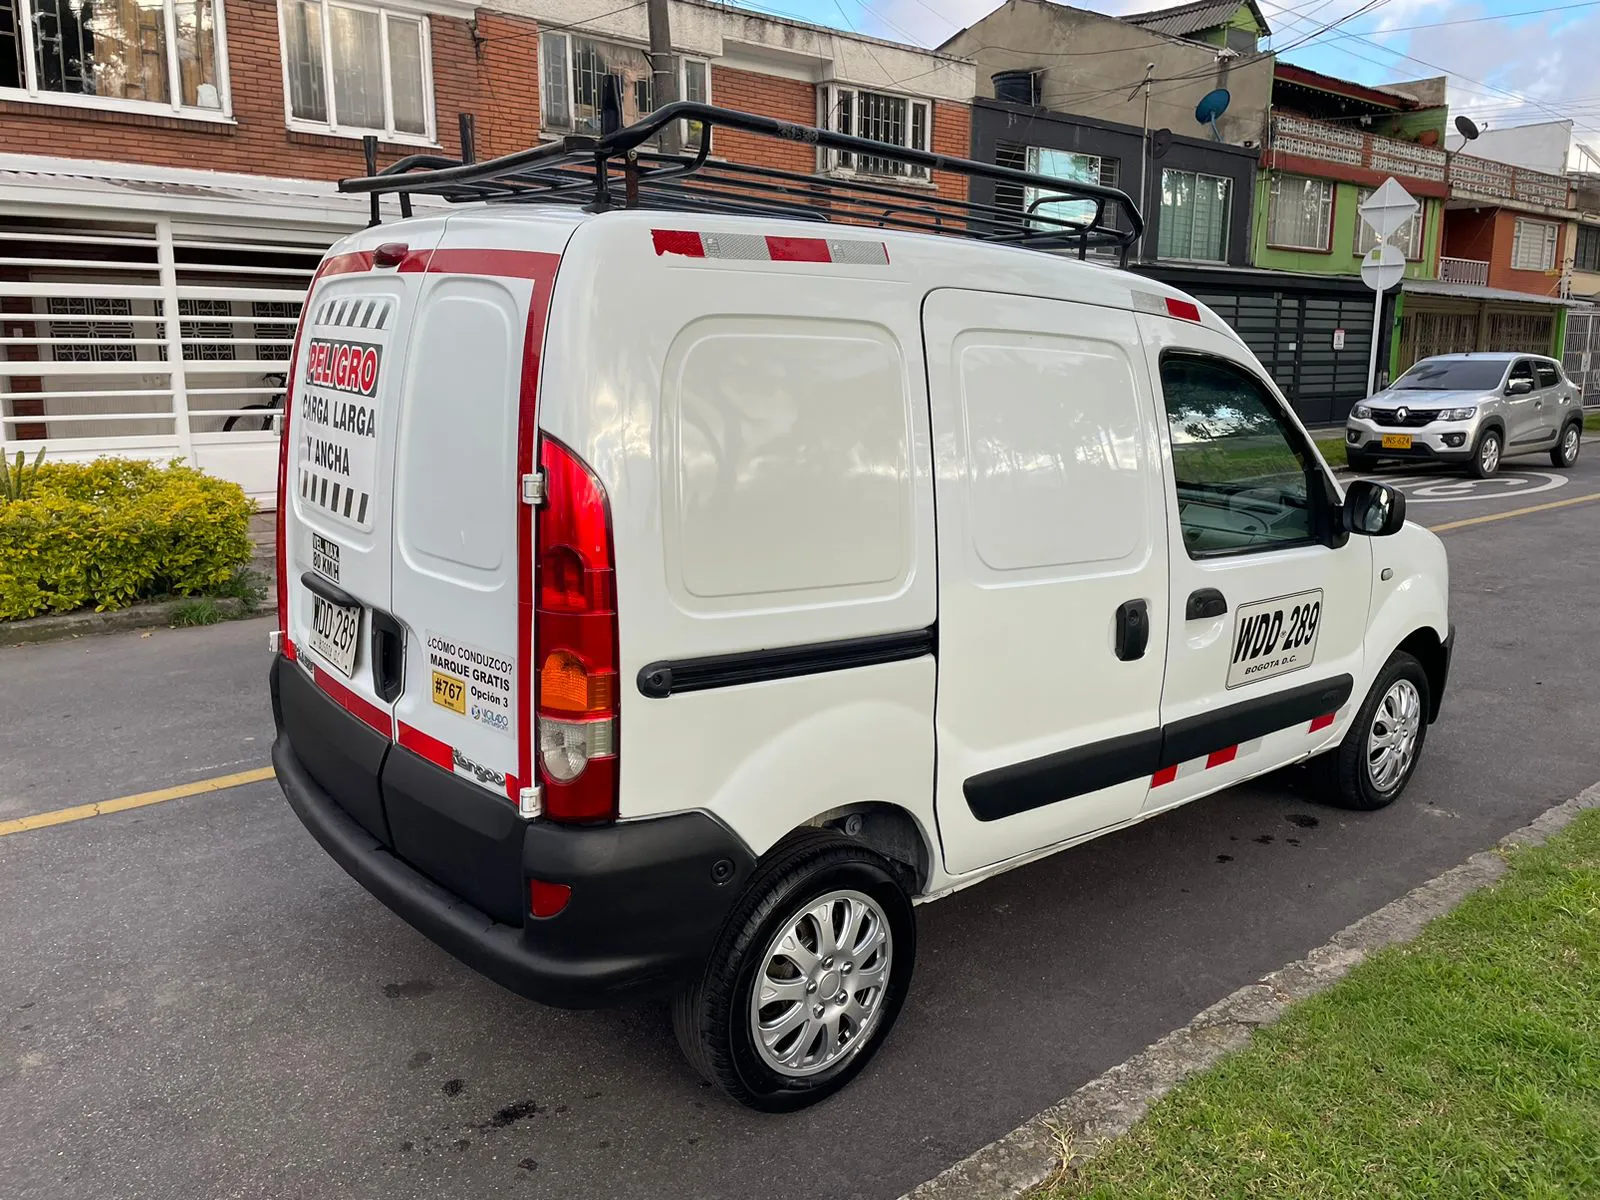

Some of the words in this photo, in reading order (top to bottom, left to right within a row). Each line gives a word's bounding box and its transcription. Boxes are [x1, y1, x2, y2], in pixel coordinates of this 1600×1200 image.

[307, 342, 377, 394] PELIGRO
[303, 394, 328, 425] CARGA
[333, 401, 375, 438] LARGA
[307, 436, 312, 462] Y
[315, 440, 349, 476] ANCHA
[313, 597, 333, 640] WDD
[333, 609, 355, 653] 289
[1233, 610, 1283, 664] WDD
[1281, 601, 1320, 651] 289
[427, 635, 456, 656] ¿CÓMO
[457, 648, 512, 675] CONDUZCO?
[430, 653, 470, 678] MARQUE
[472, 668, 510, 692] GRATIS
[1245, 660, 1279, 674] BOGOTA
[1281, 655, 1297, 665] D.C.
[435, 677, 462, 702] #767
[471, 686, 500, 706] Opción
[502, 696, 509, 708] 3
